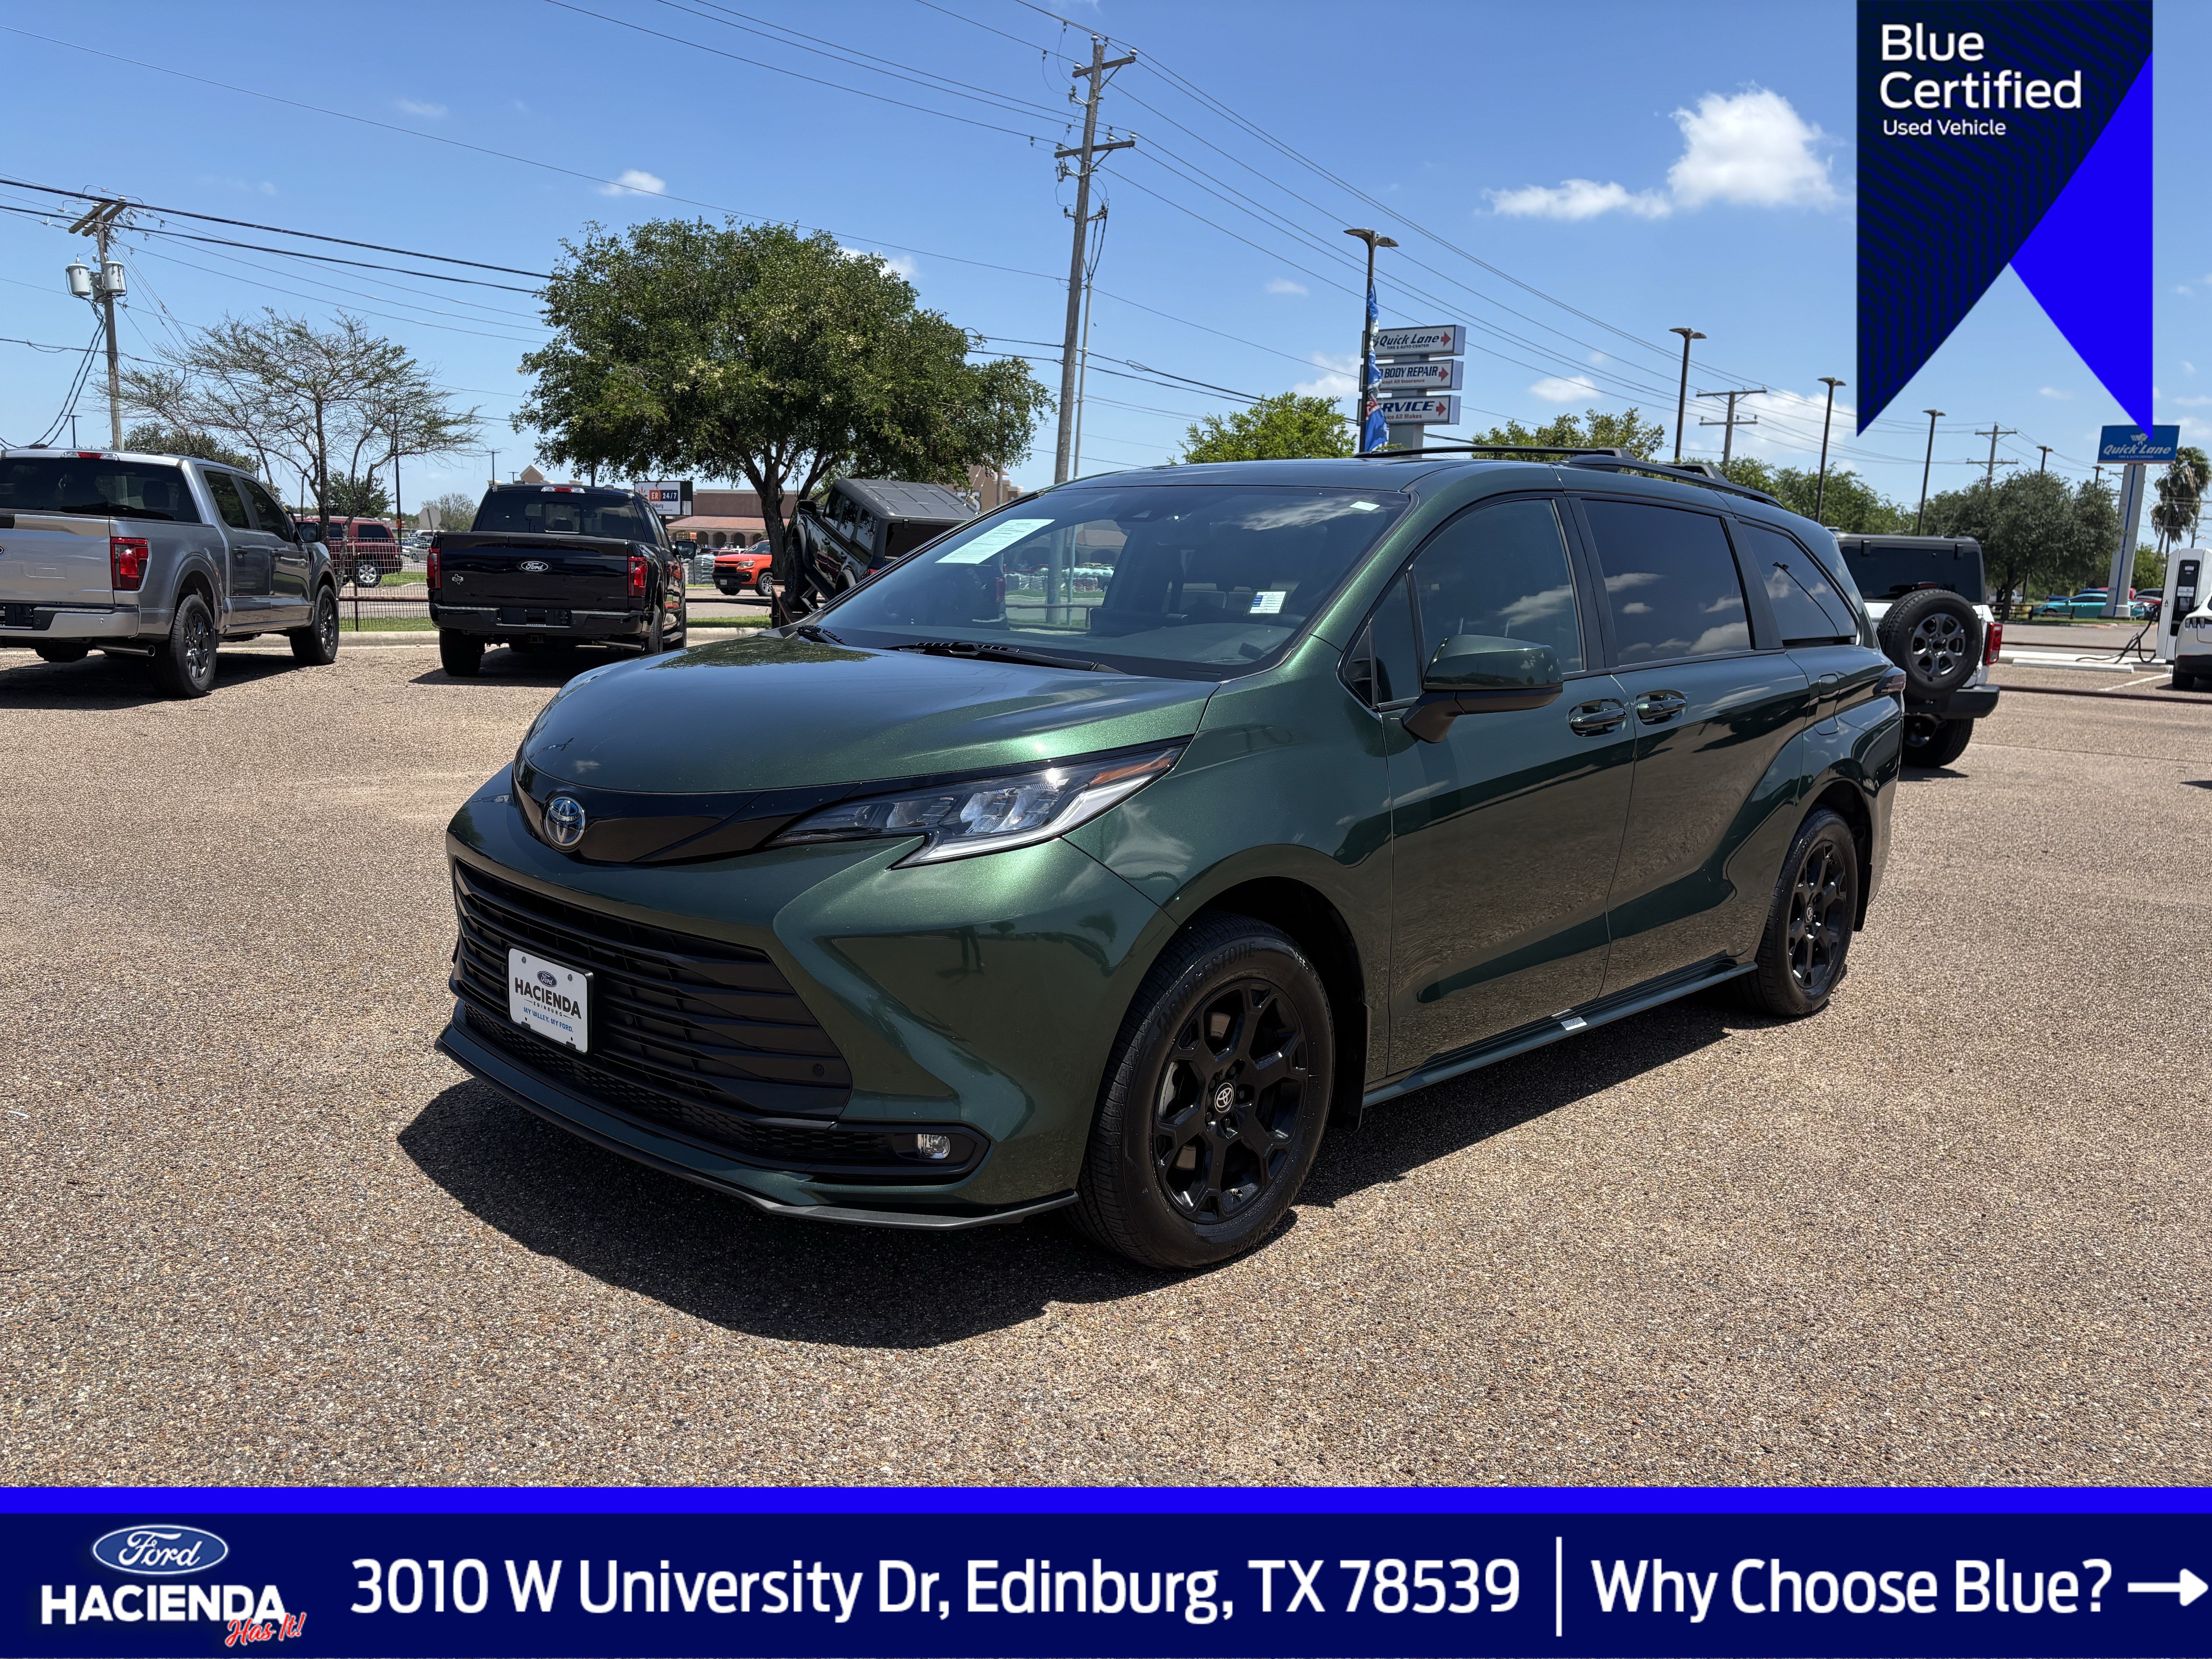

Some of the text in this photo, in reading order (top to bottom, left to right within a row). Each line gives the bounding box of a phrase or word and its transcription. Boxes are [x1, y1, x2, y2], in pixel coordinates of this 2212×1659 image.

[1380, 334, 1439, 347] Quick Lane
[1384, 368, 1407, 378] BODY
[1407, 366, 1438, 377] REPAIR
[2103, 444, 2172, 455] Quick Lane
[542, 972, 553, 986] Ford
[515, 977, 582, 1020] HACIENDA
[533, 1001, 563, 1017] EDINBURG
[551, 1018, 559, 1027] MY
